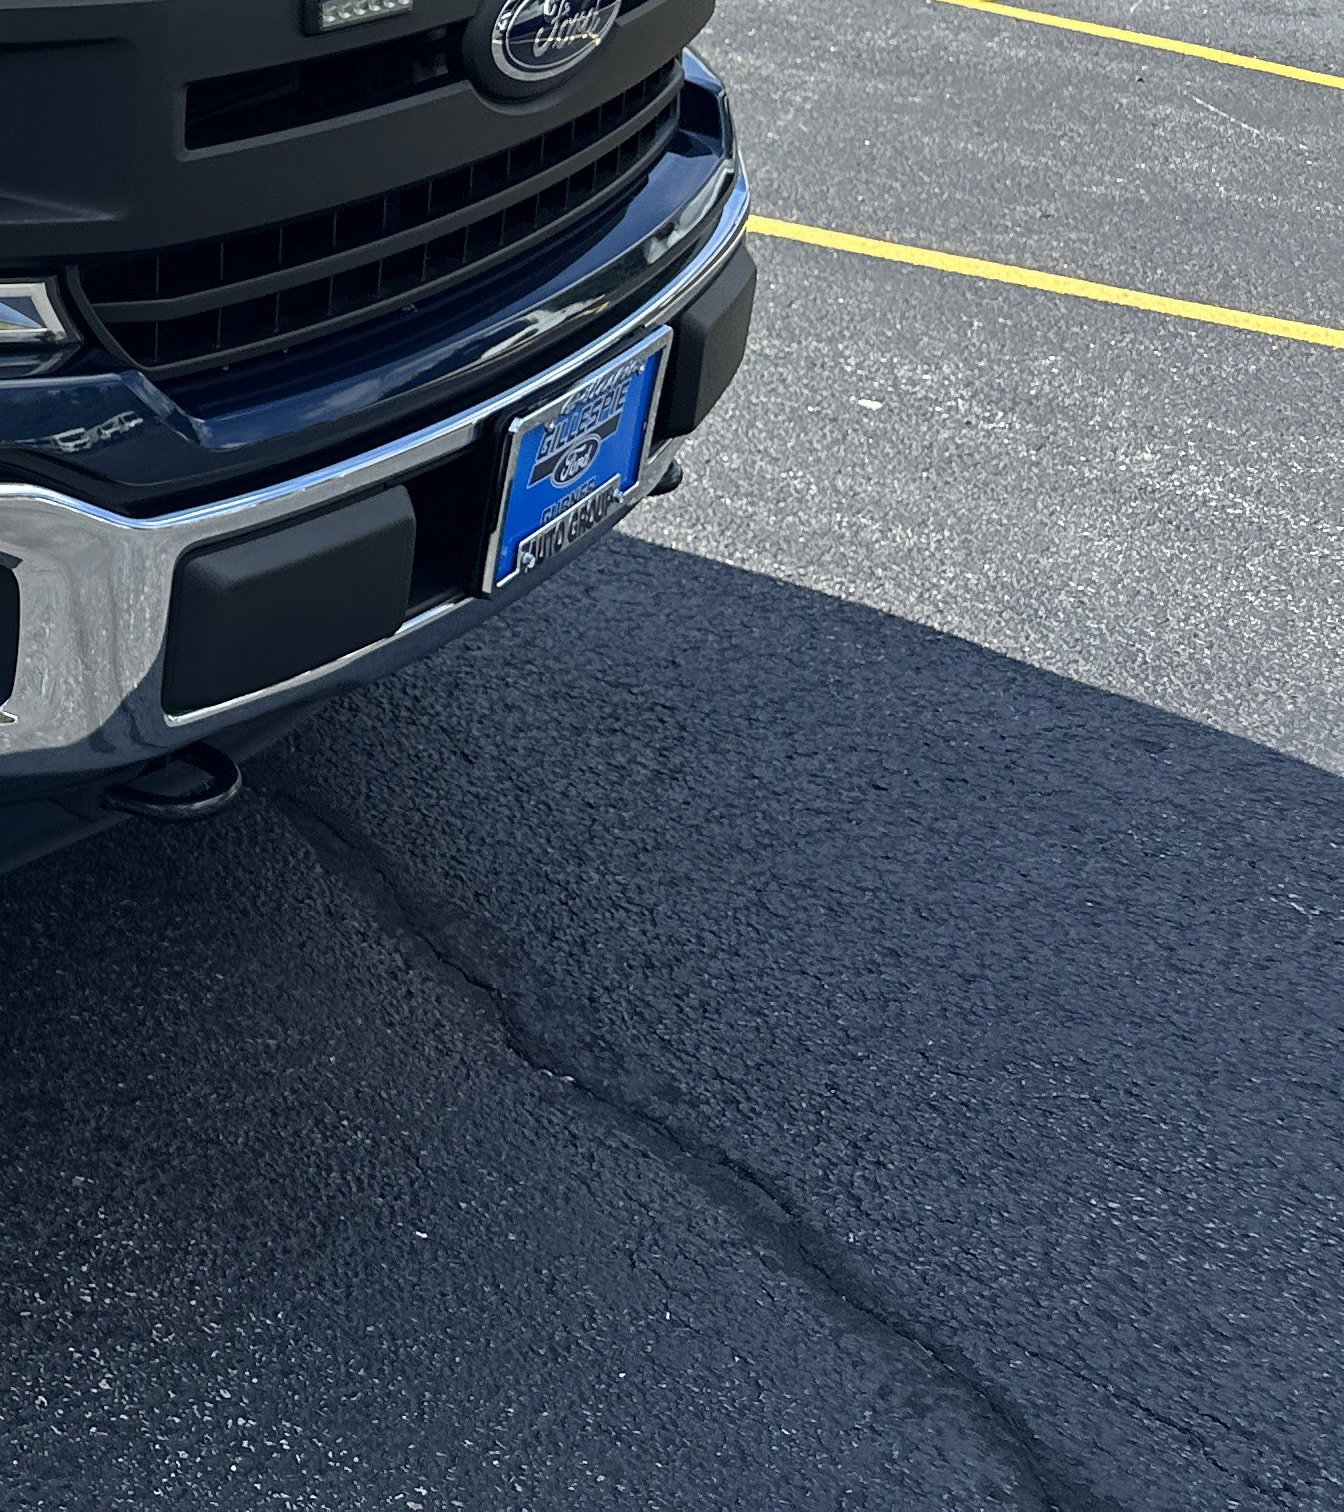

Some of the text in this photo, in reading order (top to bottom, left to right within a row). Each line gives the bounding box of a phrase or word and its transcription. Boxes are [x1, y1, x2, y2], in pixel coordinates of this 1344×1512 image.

[535, 377, 633, 464] GILLESPIE
[560, 443, 593, 482] Ford
[524, 485, 614, 565] AUTO GROUP
